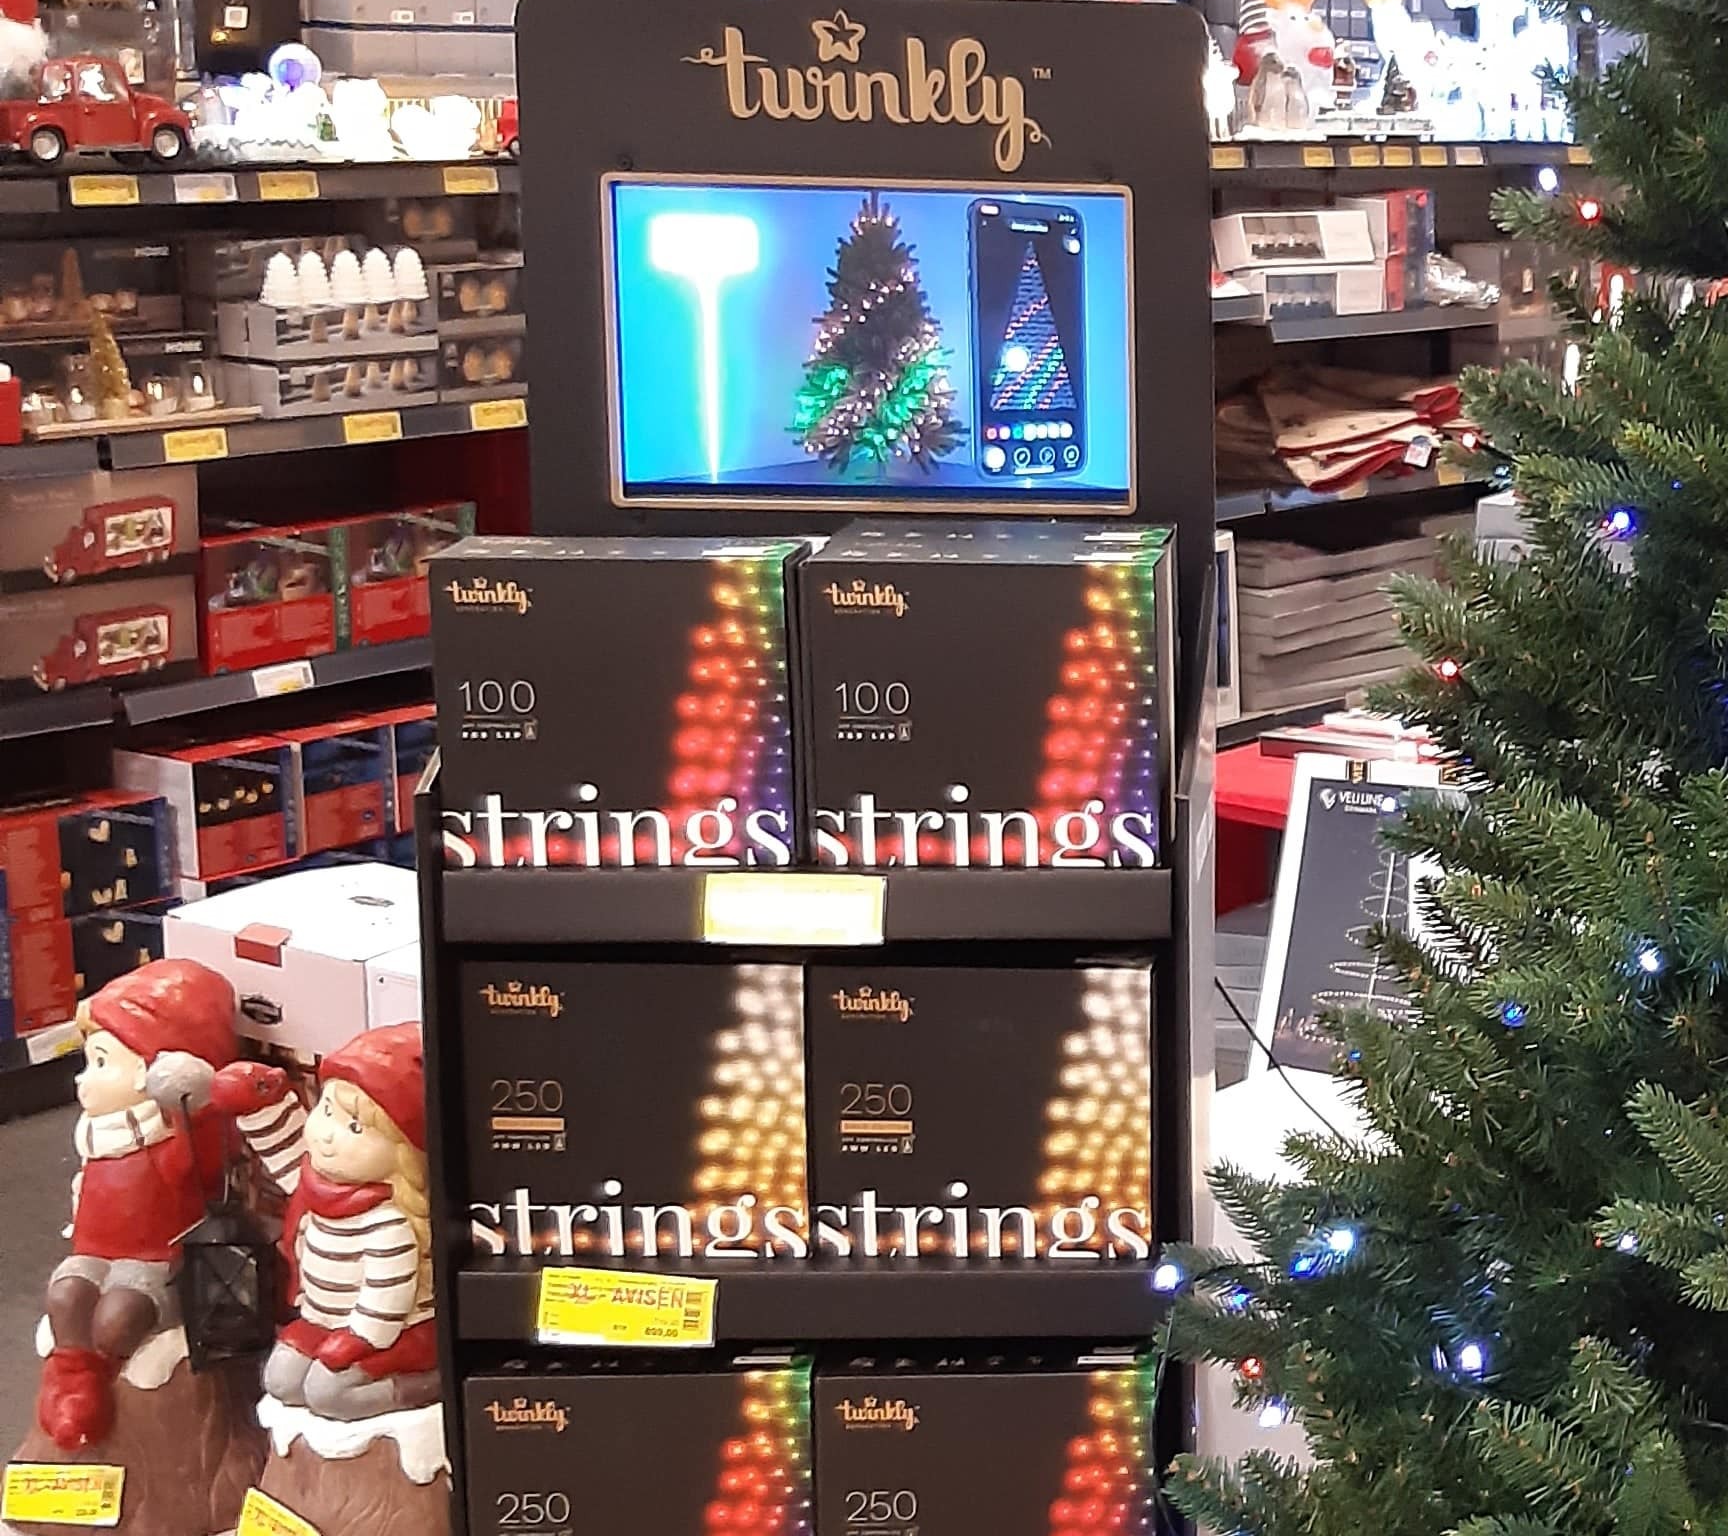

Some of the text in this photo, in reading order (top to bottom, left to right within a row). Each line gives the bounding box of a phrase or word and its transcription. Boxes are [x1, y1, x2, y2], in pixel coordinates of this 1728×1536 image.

[680, 9, 1051, 171] twinkly
[443, 577, 532, 614] twinkly
[822, 579, 910, 616] twinkly
[458, 680, 537, 713] 100
[835, 681, 911, 714] 100
[441, 783, 792, 867] strings
[815, 784, 1157, 867] strings
[478, 980, 564, 1017] twinkly
[831, 985, 914, 1022] twinkly
[490, 1079, 563, 1112] 250
[840, 1083, 912, 1115] 250
[470, 1179, 808, 1258] strings
[815, 1180, 1150, 1259] strings
[484, 1397, 570, 1432] twinkly
[835, 1395, 919, 1430] twinkly
[496, 1492, 570, 1524] 250
[845, 1490, 917, 1521] 250
